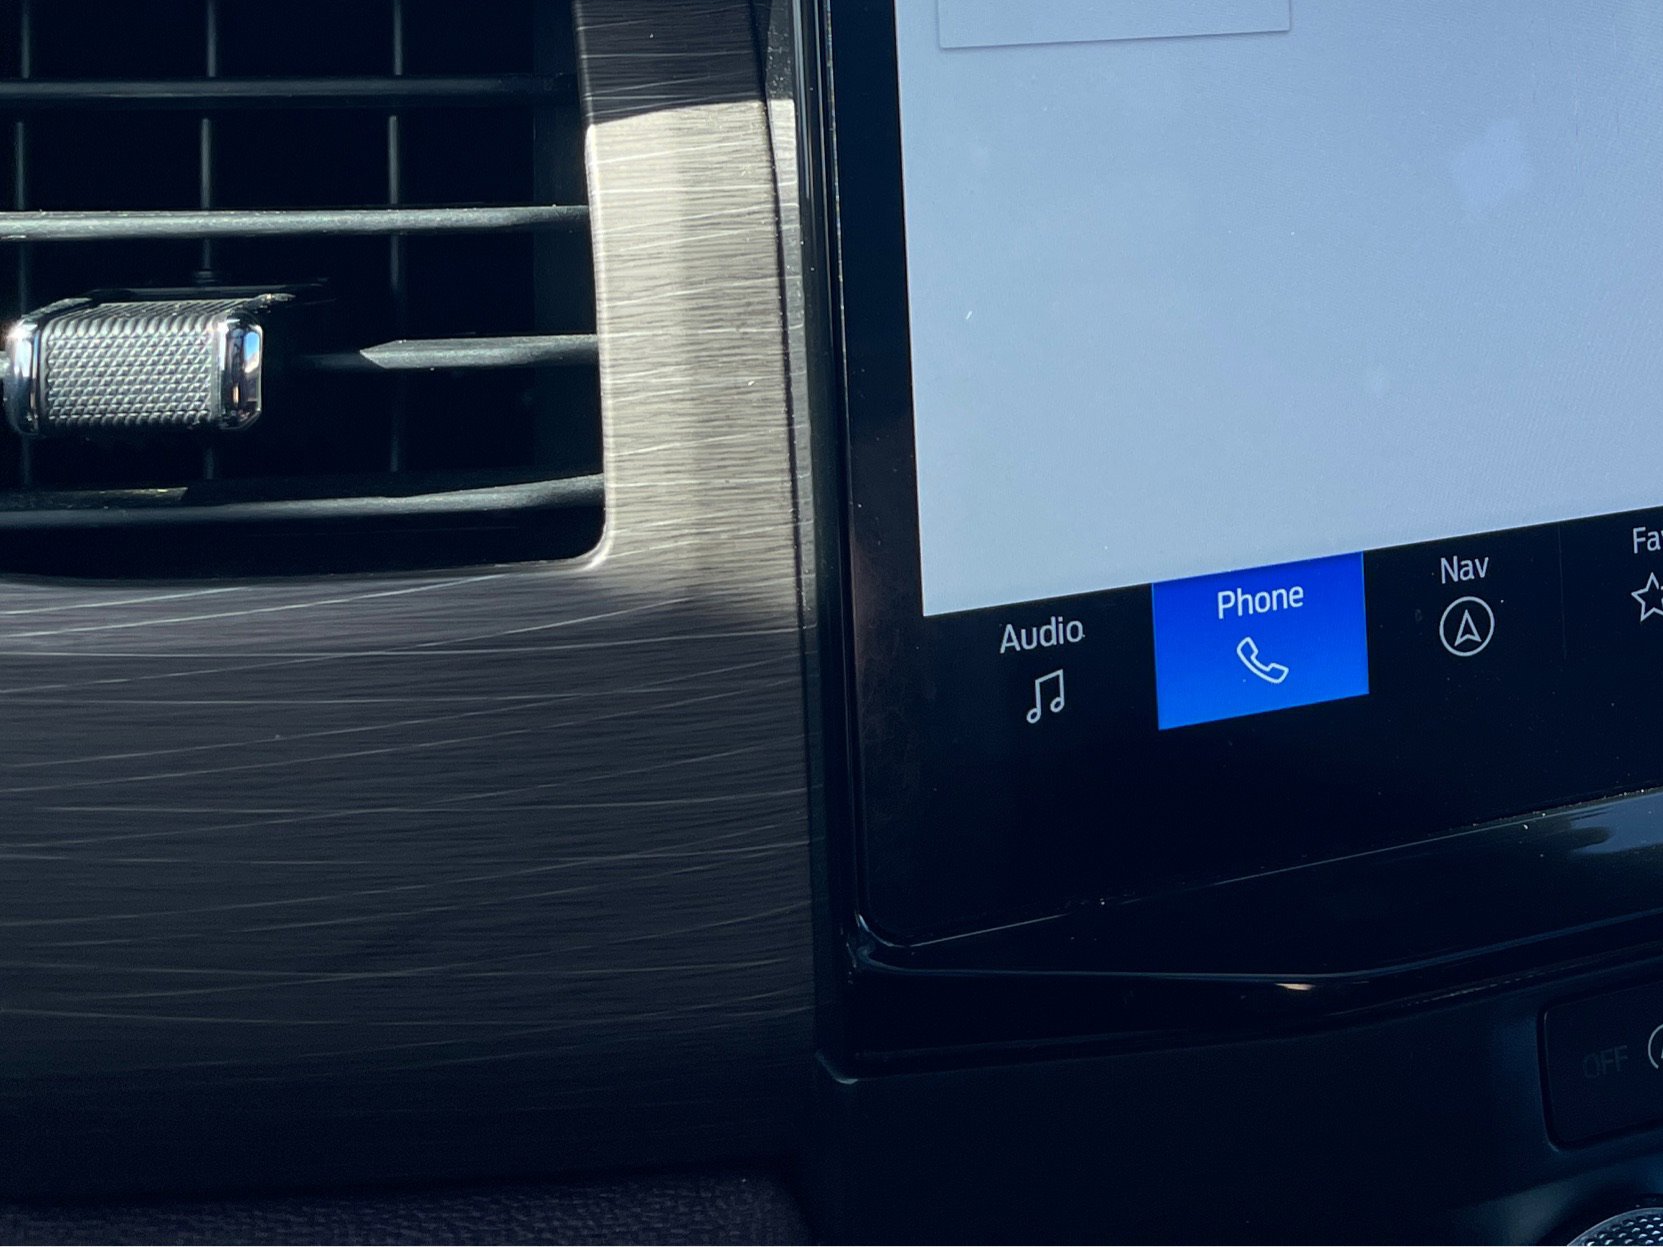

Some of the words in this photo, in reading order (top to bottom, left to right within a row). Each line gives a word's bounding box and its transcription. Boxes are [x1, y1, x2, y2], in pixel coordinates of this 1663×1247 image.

[1440, 554, 1490, 585] Nav
[1217, 582, 1304, 620] Phone
[1000, 616, 1085, 654] Audio
